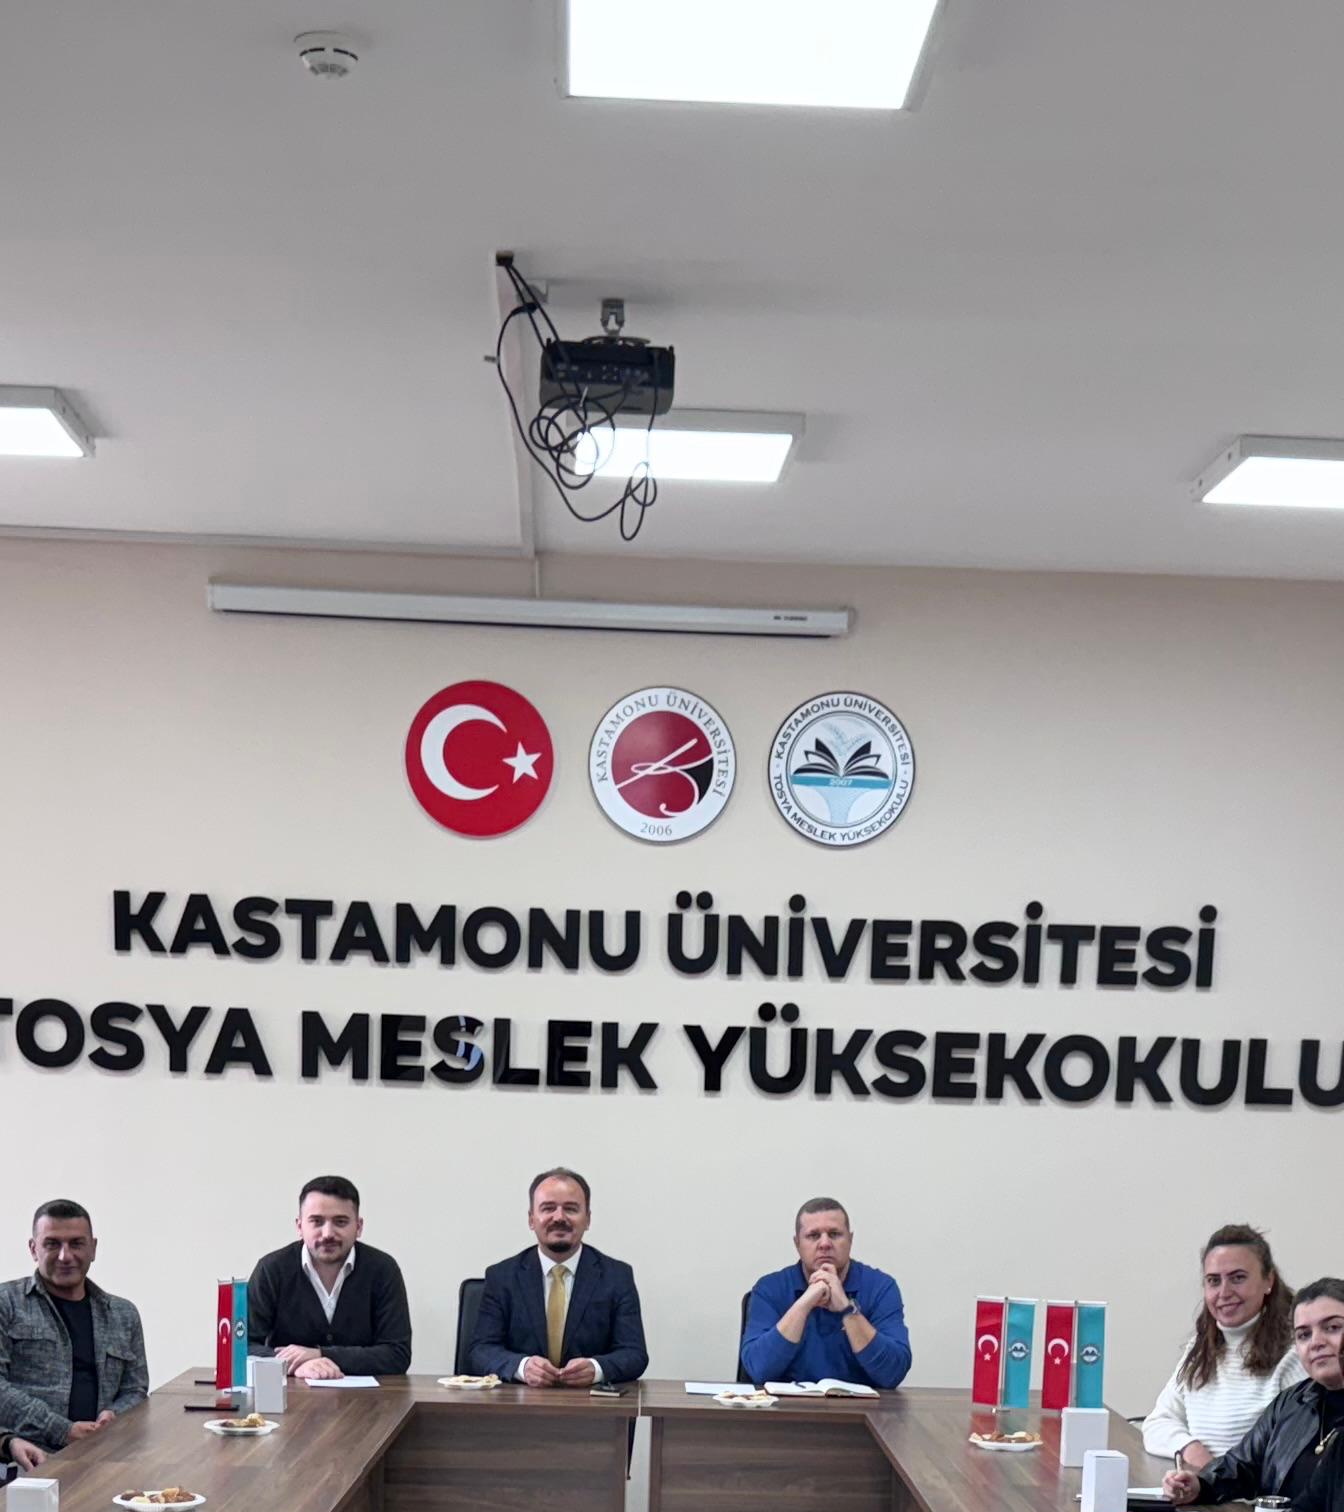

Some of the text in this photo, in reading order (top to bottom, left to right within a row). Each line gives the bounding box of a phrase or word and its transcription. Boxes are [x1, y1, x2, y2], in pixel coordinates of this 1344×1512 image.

[597, 695, 658, 782] KASTAMONU
[775, 698, 840, 759] KASTAMONU
[640, 822, 672, 836] 2006
[774, 774, 909, 841] TOSYA MESLEK YÜKSEKOKULU
[112, 889, 1217, 987] KASTAMONU ÜNİVERSİTESİ
[301, 1010, 660, 1092] MESLEK
